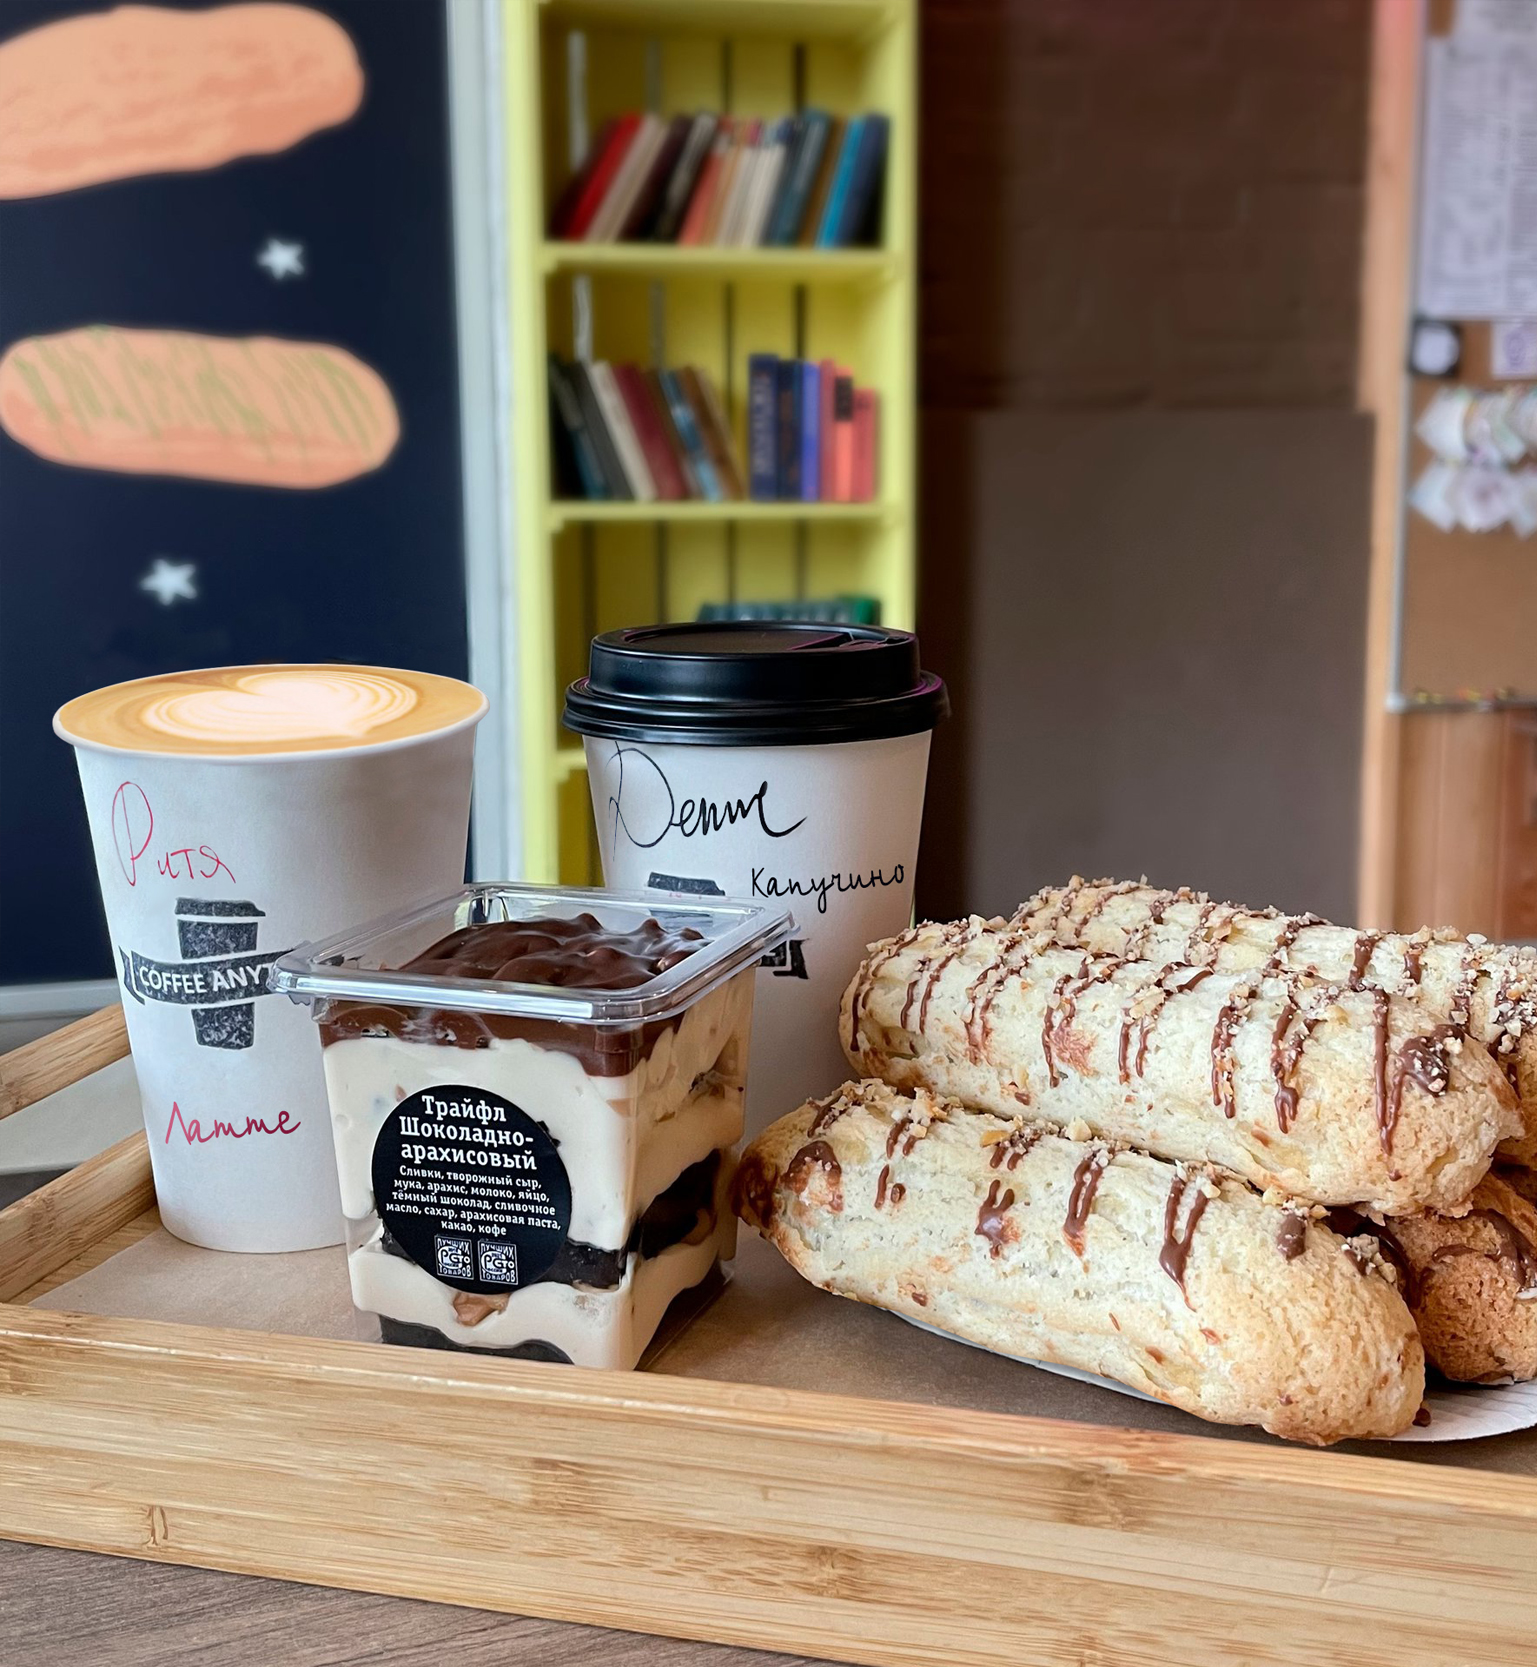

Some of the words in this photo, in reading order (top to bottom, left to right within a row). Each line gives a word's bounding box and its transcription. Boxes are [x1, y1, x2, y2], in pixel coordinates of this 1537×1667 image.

[139, 966, 207, 994] COFFEE
[422, 1095, 507, 1125] Трайфл
[399, 1116, 534, 1148] Шоколадно-
[401, 1143, 537, 1170] арахисовый
[394, 1179, 425, 1191] мука,
[427, 1182, 468, 1195] арахис,
[471, 1186, 516, 1200] молоко,
[518, 1189, 550, 1203] яйцо,
[399, 1165, 444, 1180] Сливки,
[446, 1171, 513, 1186] творожный
[515, 1178, 542, 1190] сыр,
[392, 1189, 437, 1203] тёмный
[440, 1196, 492, 1210] шоколад,
[494, 1201, 556, 1216] сливочное
[386, 1203, 422, 1215] масло,
[424, 1206, 458, 1220] сахар,
[460, 1210, 525, 1225] арахисовая
[527, 1217, 561, 1231] паста,
[441, 1220, 476, 1233] какао,
[478, 1224, 507, 1237] кофе
